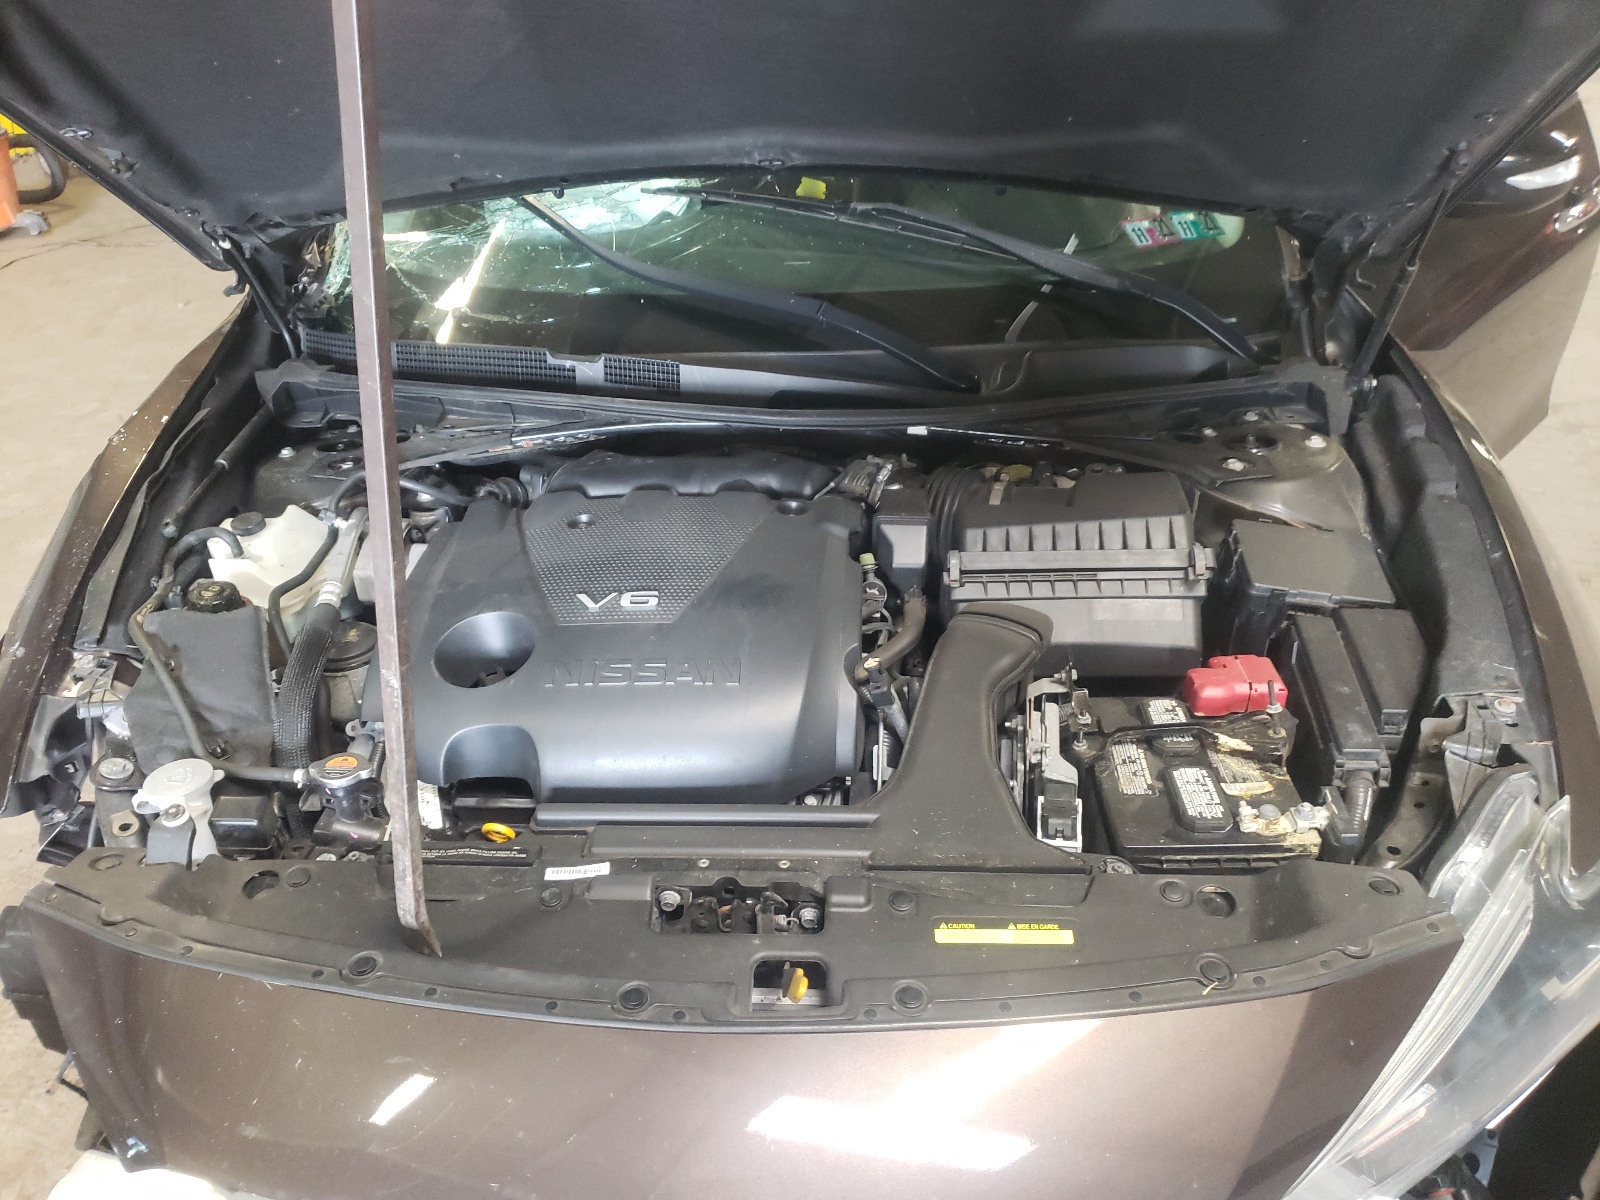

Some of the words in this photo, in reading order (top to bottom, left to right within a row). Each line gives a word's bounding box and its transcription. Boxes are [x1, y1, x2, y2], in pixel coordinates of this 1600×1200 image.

[1131, 226, 1149, 244] 11
[1177, 220, 1194, 237] 11
[575, 590, 660, 612] V6
[544, 657, 742, 687] NISSAN
